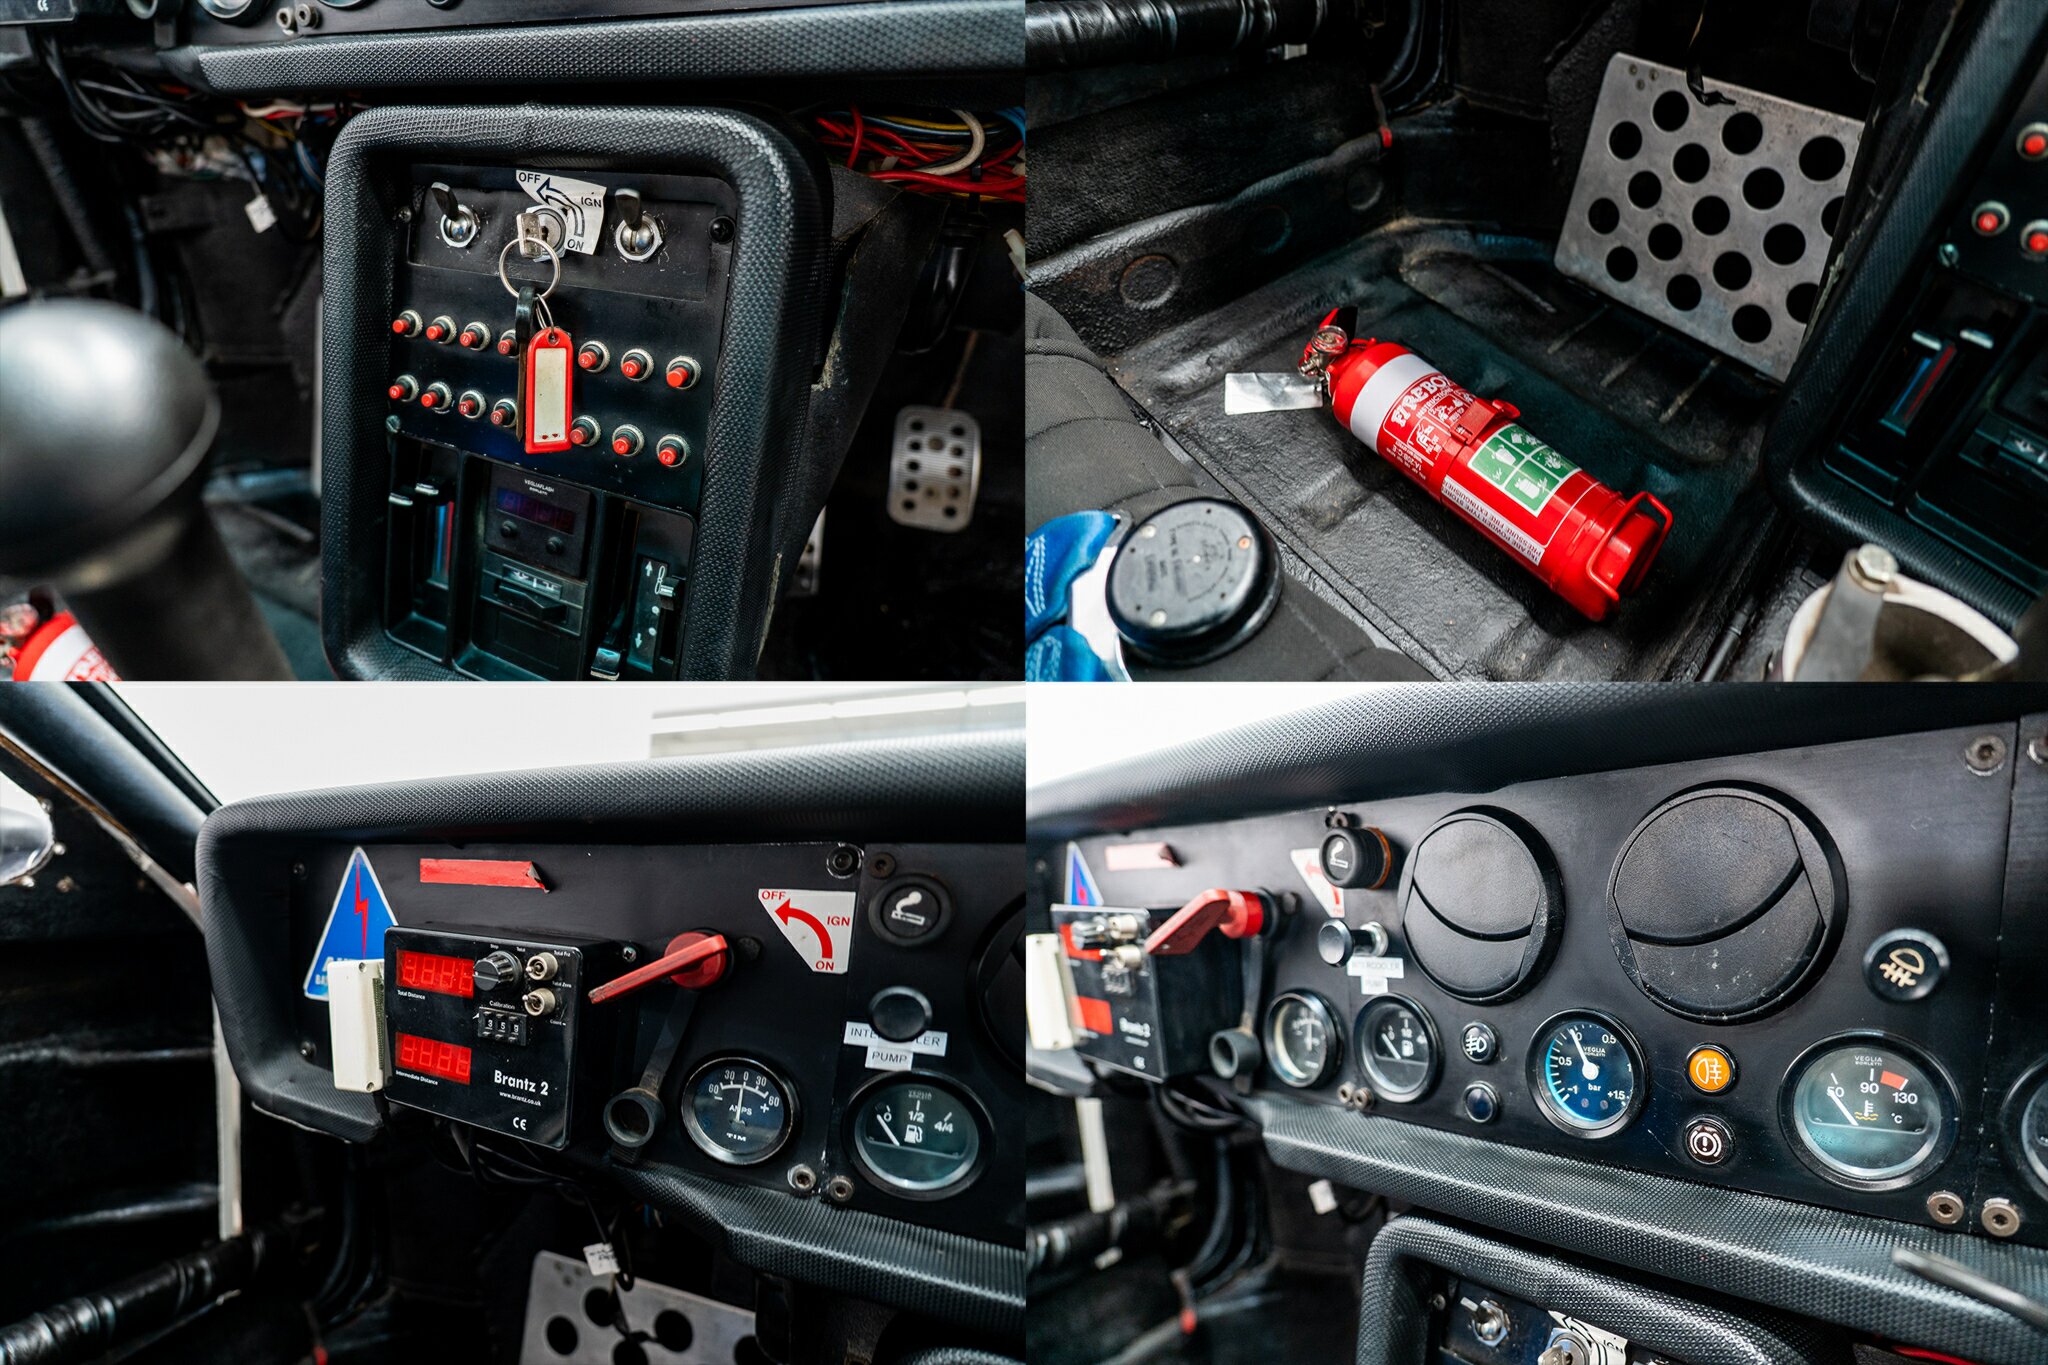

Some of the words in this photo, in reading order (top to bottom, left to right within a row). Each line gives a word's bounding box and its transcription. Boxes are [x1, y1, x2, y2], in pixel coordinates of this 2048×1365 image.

[518, 171, 541, 183] OFF
[580, 196, 602, 208] IGN
[567, 239, 584, 251] ON
[1466, 506, 1483, 521] TYPE
[1489, 515, 1505, 528] FIRE
[1482, 518, 1511, 542] POWDER
[1507, 528, 1541, 556] PRESSURE
[761, 890, 786, 900] OFF
[826, 915, 850, 927] IGN
[815, 960, 834, 971] ON
[408, 991, 426, 1000] Distance
[489, 1000, 516, 1010] Calibration
[1602, 1034, 1617, 1044] 0.5
[1582, 1046, 1606, 1054] VEGLIA
[872, 1051, 907, 1063] PUMP
[1558, 1056, 1572, 1066] 0.5
[1854, 1055, 1883, 1063] VEGLIA
[420, 1074, 438, 1086] Distance
[724, 1070, 735, 1081] 30
[743, 1071, 749, 1081] 0
[755, 1075, 767, 1087] 30
[494, 1069, 536, 1093] Brantz
[540, 1081, 549, 1096] 2
[708, 1083, 719, 1094] 60
[1588, 1083, 1601, 1091] bar
[1860, 1082, 1880, 1094] 90
[1827, 1086, 1845, 1098] 50
[1892, 1091, 1918, 1104] 130
[499, 1091, 541, 1107] www.brantz.co.uk
[768, 1096, 780, 1107] 60
[883, 1112, 892, 1122] 0
[908, 1111, 925, 1123] 1/2
[934, 1121, 954, 1133] 4/4
